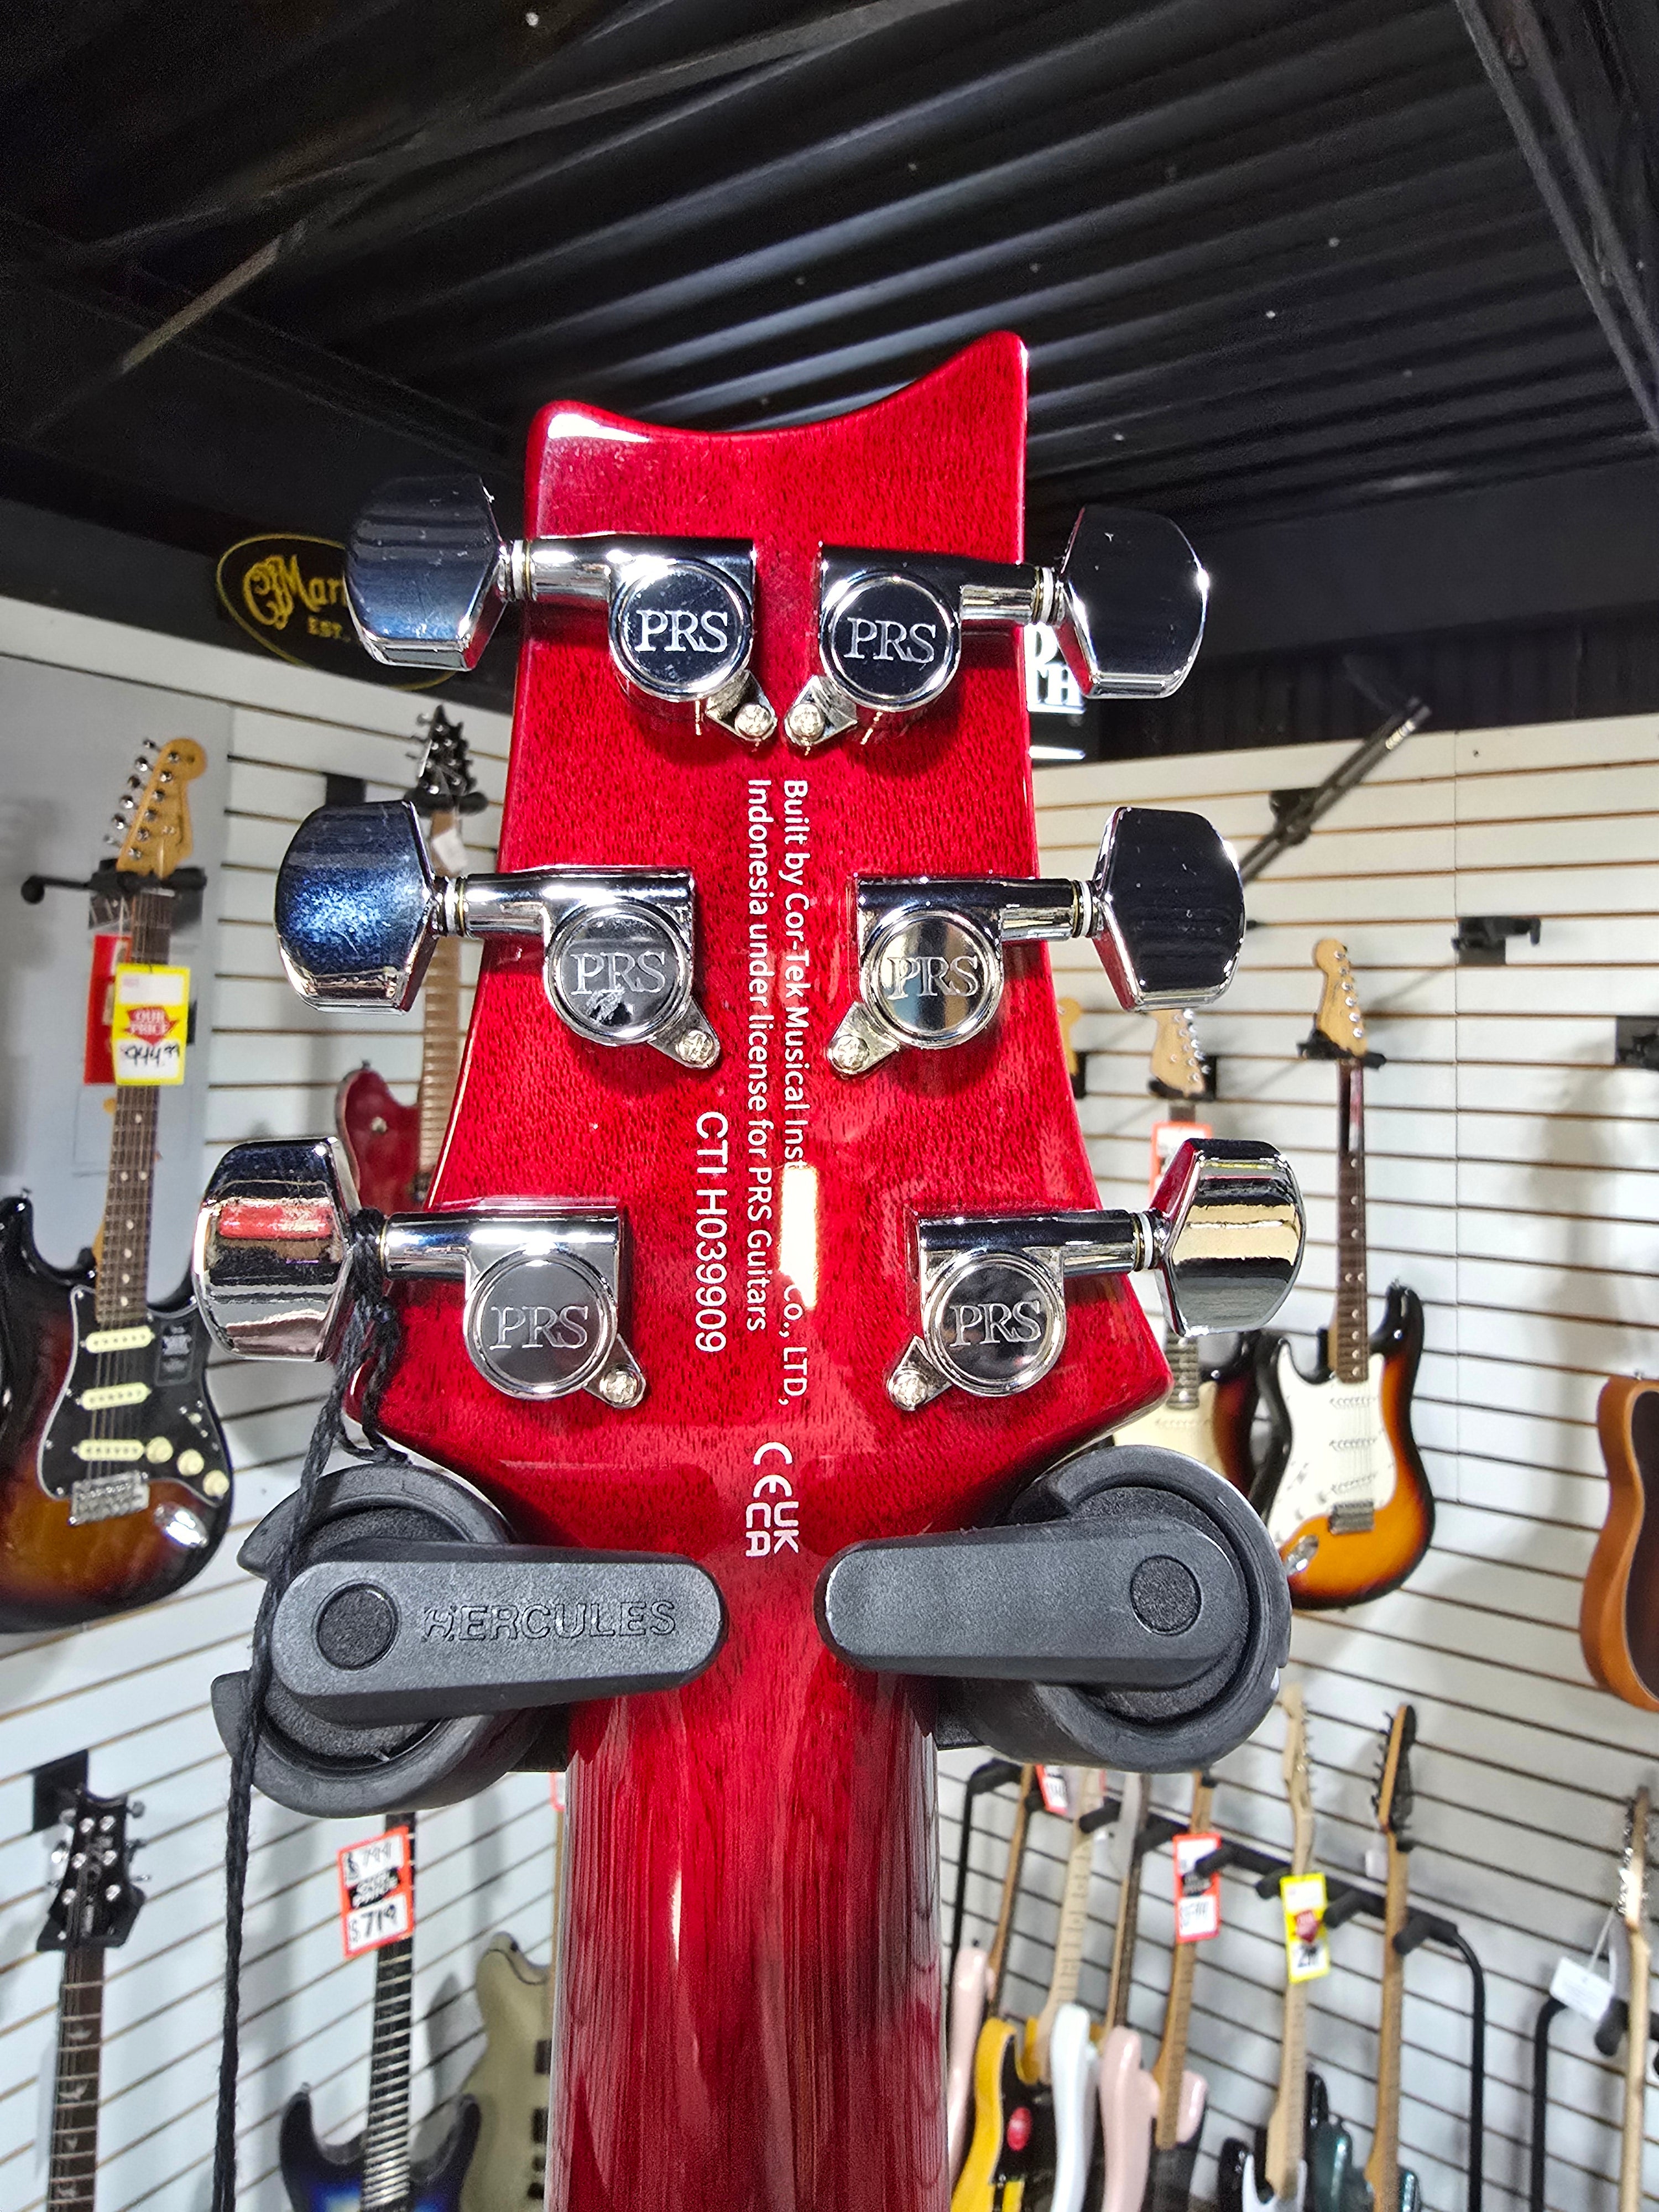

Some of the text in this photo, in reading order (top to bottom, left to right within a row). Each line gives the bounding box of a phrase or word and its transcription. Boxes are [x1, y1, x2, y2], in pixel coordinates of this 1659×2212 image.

[634, 609, 728, 653] PRS
[844, 617, 936, 664] PRS
[784, 780, 809, 845] Built
[778, 853, 810, 885] by
[785, 893, 811, 998] Cor-Tek
[571, 952, 666, 995] PRS
[886, 955, 980, 1000] PRS
[747, 780, 775, 1331] Indonesia under license for PRS Guitars
[784, 1006, 810, 1111] Musical
[695, 1112, 728, 1352] CTI H039909
[491, 1305, 590, 1349] PRS
[948, 1300, 1042, 1347] PRS
[778, 1347, 807, 1405] LTD,
[773, 1501, 799, 1554] UK
[421, 1600, 676, 1642] HERCULES
